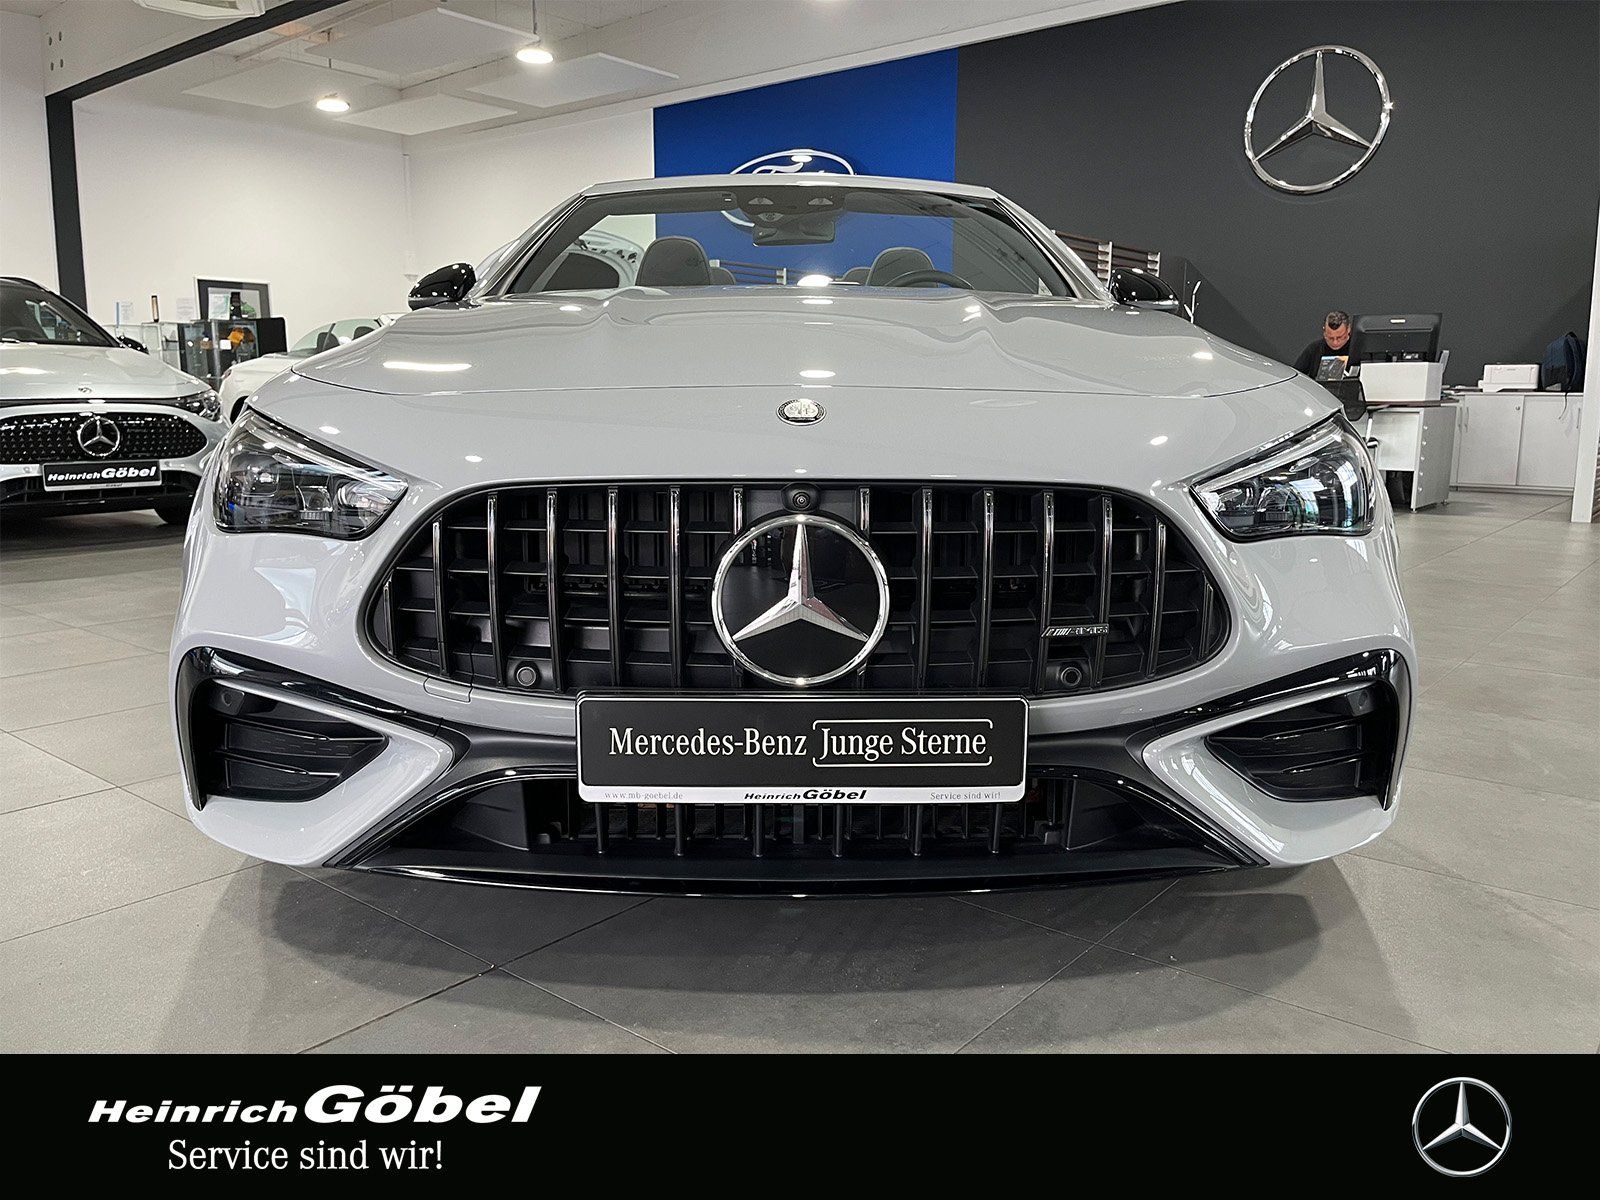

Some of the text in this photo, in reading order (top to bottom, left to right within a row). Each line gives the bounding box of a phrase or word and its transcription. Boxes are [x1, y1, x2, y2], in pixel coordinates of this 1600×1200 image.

[47, 466, 157, 481] Heinrich Göbel
[608, 727, 987, 762] Mercedes-Benz Junge Sterne
[802, 789, 867, 800] Göbel
[930, 792, 961, 800] Service
[963, 791, 981, 800] sind
